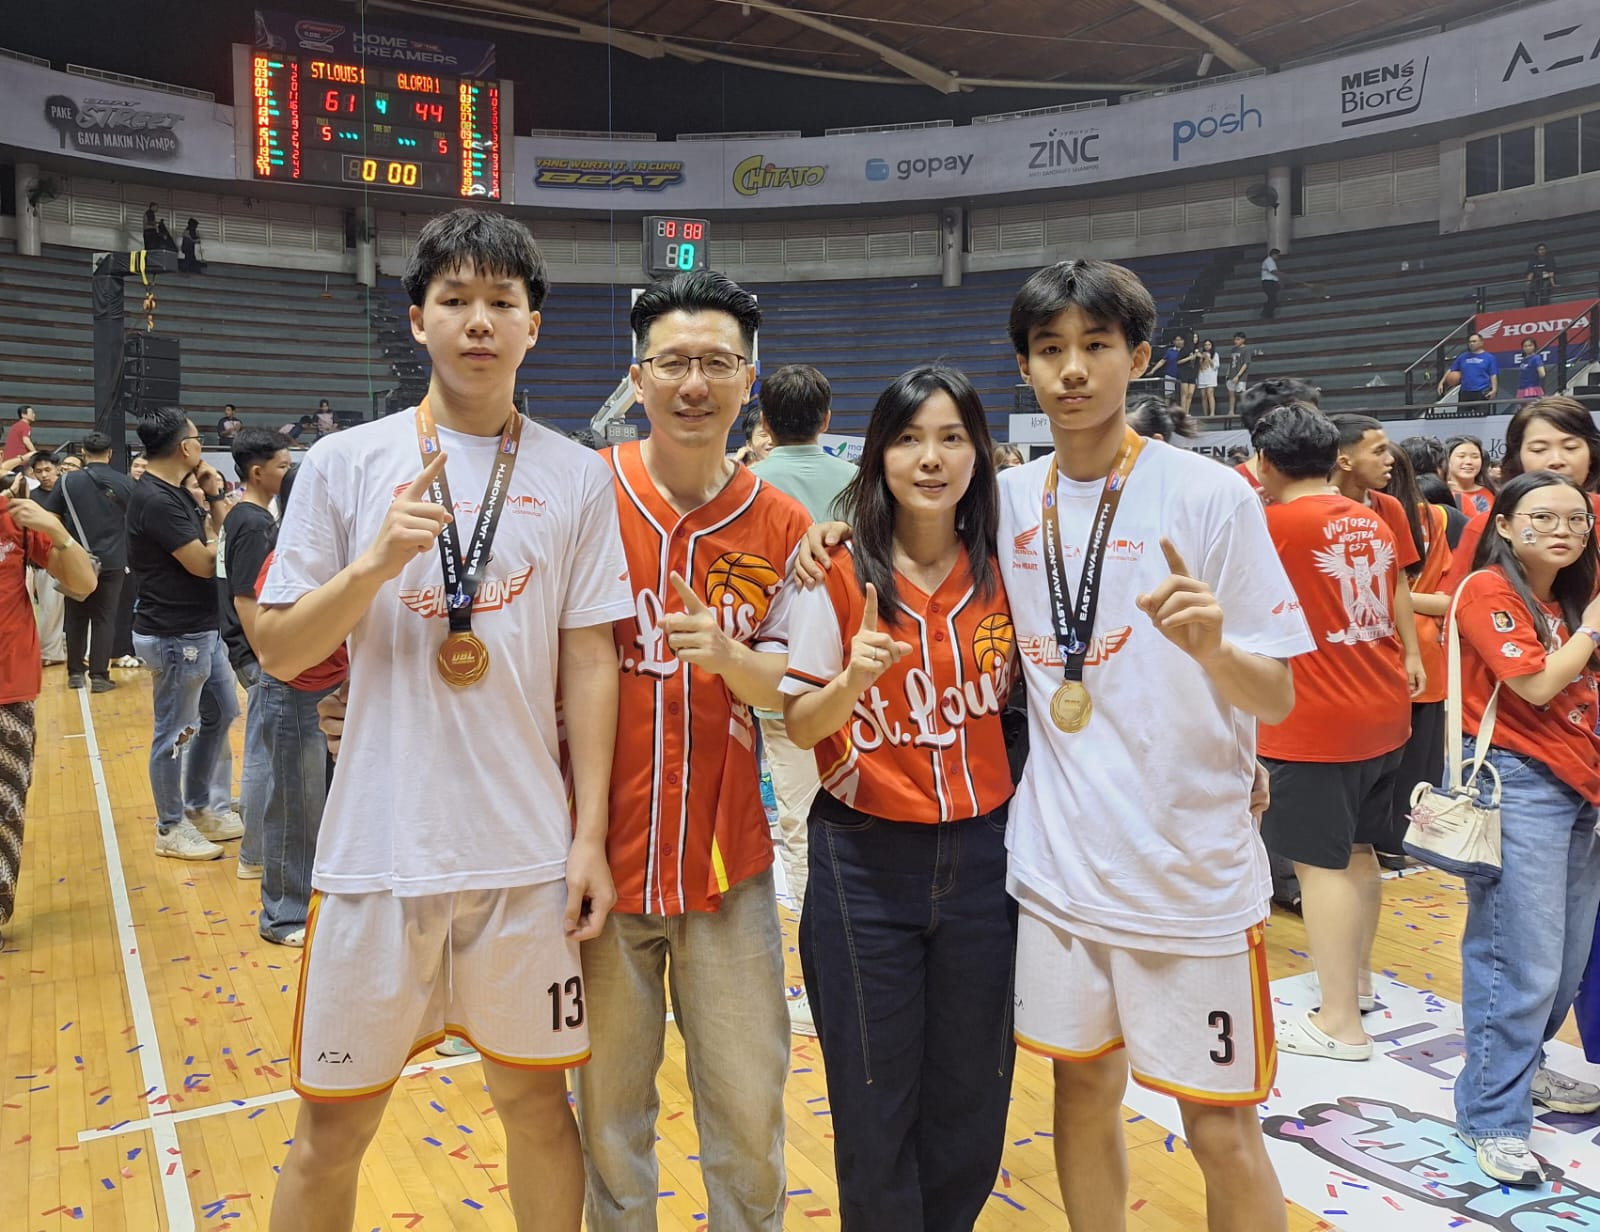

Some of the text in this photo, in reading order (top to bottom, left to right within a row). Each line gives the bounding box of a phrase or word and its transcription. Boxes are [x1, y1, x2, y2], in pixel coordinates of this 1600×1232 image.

[353, 32, 408, 48] HOME
[353, 44, 458, 65] DREAMERS
[1502, 24, 1600, 82] AZ
[311, 62, 325, 79] ST
[327, 63, 358, 84] LOUIS
[397, 73, 433, 92] GLORIA
[325, 90, 355, 112] 61
[375, 99, 387, 115] 4
[1341, 78, 1414, 114] Bioré
[51, 105, 72, 120] PAKE
[415, 103, 443, 122] 44
[321, 126, 332, 141] 5
[1173, 94, 1262, 161] posh
[78, 132, 100, 146] GAYA
[103, 133, 133, 149] MAKIN
[438, 139, 448, 154] 5
[896, 154, 974, 181] gopay
[1503, 316, 1590, 337] HONDA
[1514, 351, 1551, 364] ET
[467, 463, 507, 576] EAST JAVA-NORTH
[1323, 516, 1379, 540] VICTORIA
[1339, 530, 1375, 543] NOSTRA
[445, 547, 457, 584] EAST
[1078, 502, 1111, 621] EAST JAVA-NORTH
[1046, 518, 1069, 636] EAST JAVA-NORTH
[547, 975, 584, 1032] 13
[1208, 1010, 1235, 1066] 3
